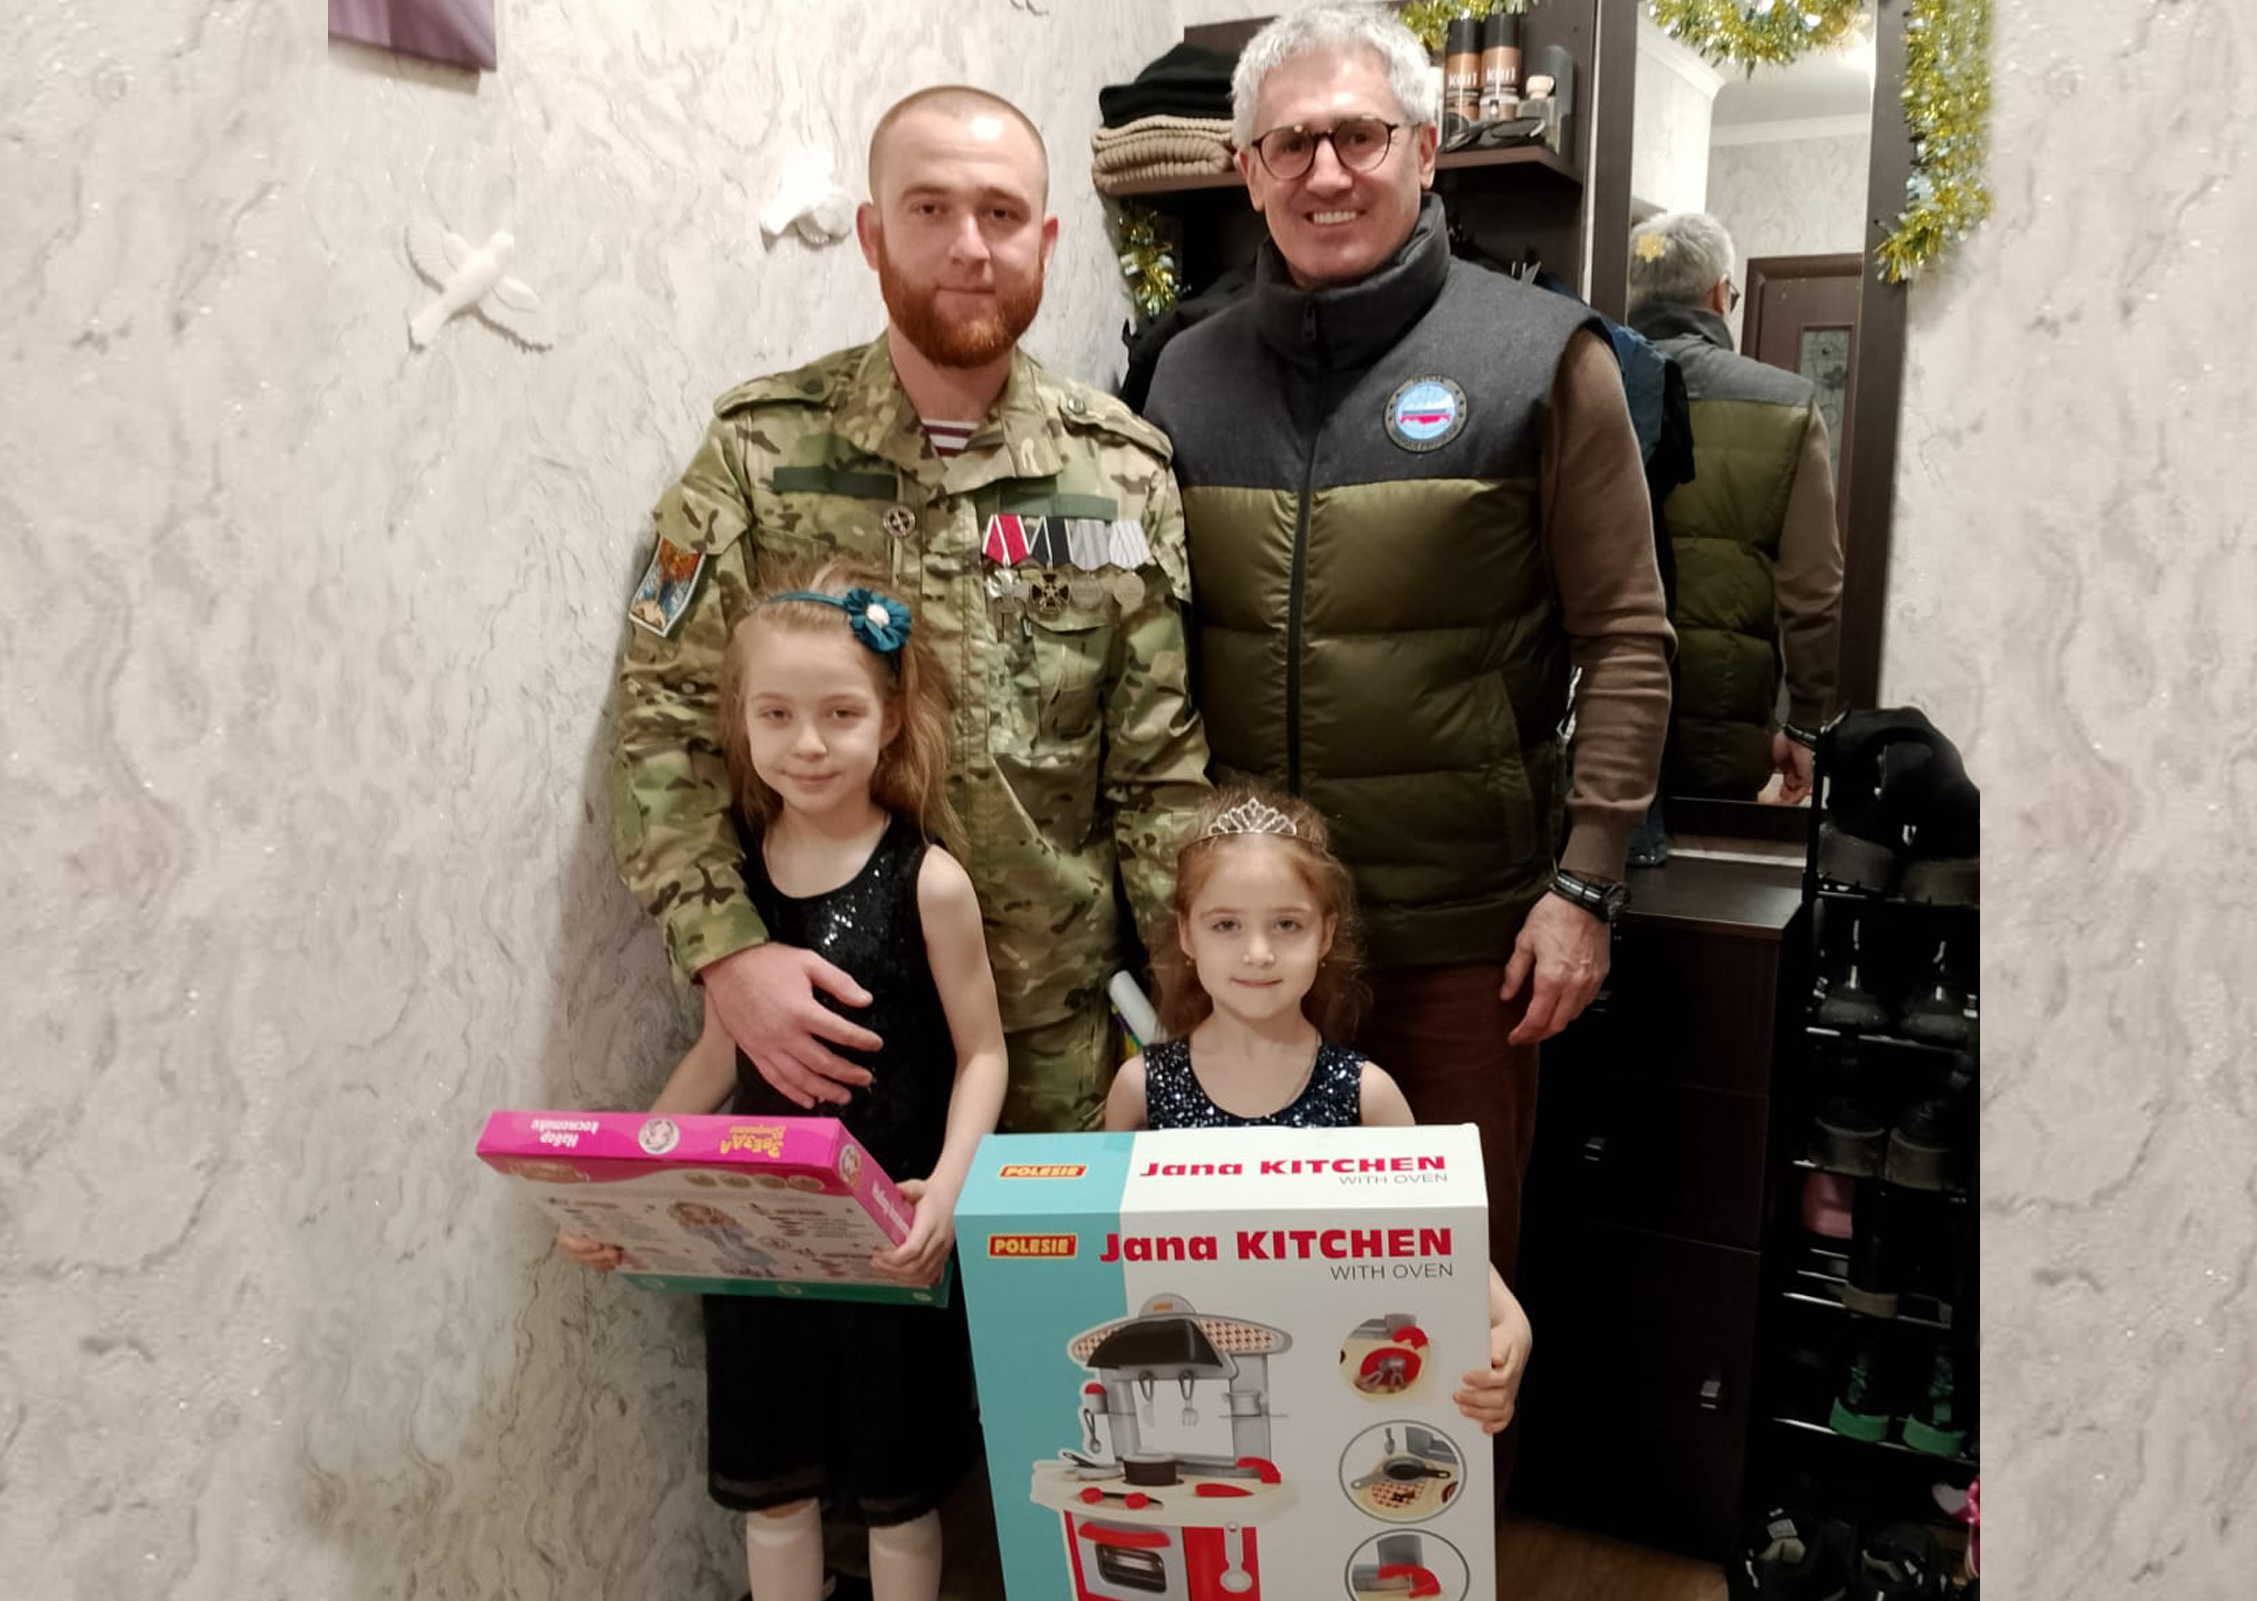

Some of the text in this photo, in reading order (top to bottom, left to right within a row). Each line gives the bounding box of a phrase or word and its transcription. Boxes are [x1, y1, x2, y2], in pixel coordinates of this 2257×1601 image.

[1002, 1166, 1079, 1177] POLESIE
[1139, 1155, 1446, 1177] Jana KITCHEN
[1339, 1173, 1448, 1186] WITH OVEN
[993, 1237, 1070, 1254] POLESIE
[1099, 1227, 1452, 1262] Jana KITCHEN
[1330, 1262, 1454, 1281] WITH OVEN
